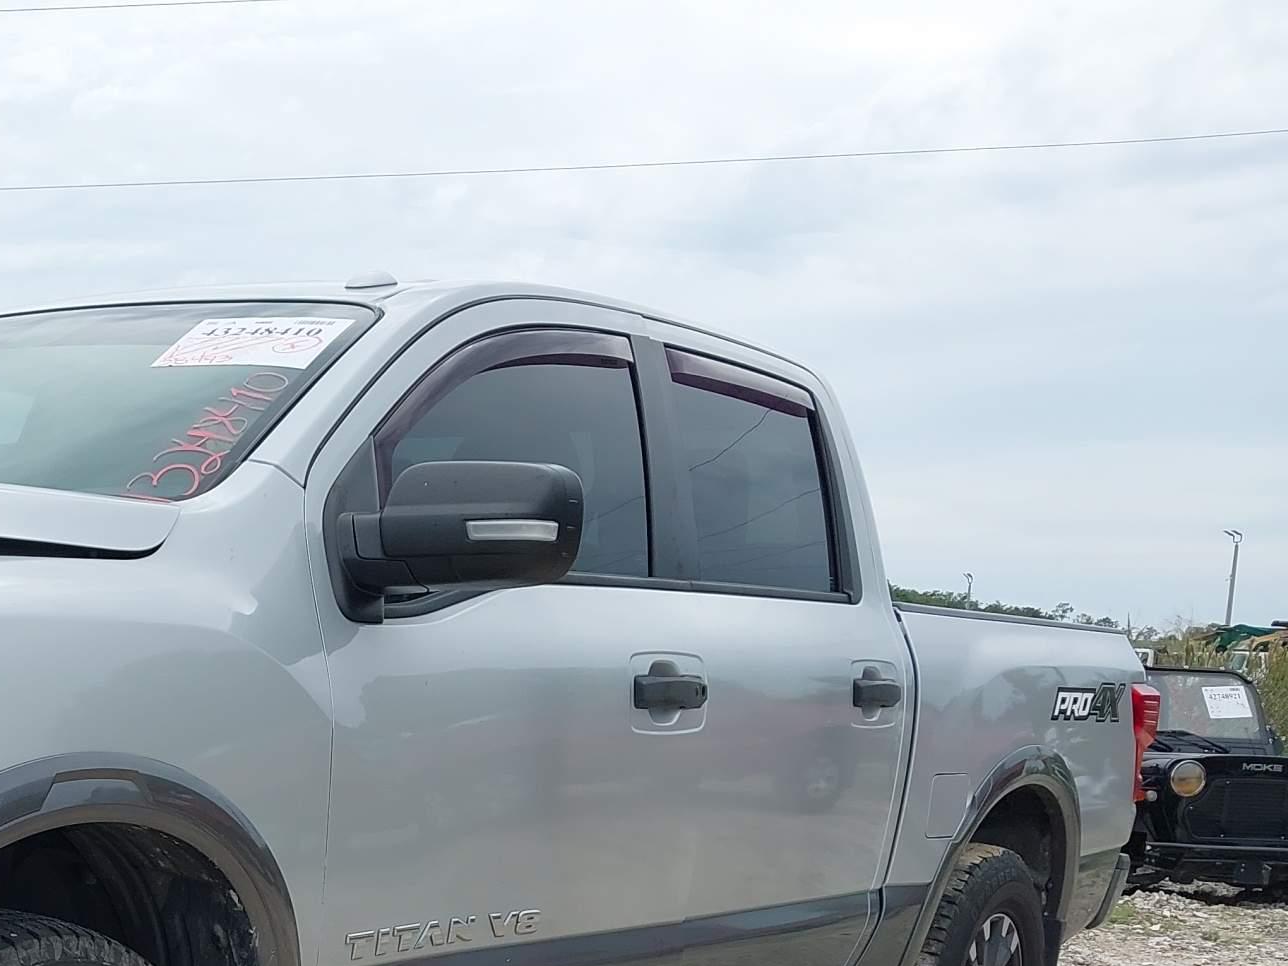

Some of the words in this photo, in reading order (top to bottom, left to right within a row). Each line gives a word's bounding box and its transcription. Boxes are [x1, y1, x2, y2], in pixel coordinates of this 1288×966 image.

[201, 326, 323, 337] 43248410
[121, 372, 288, 503] 3248410
[1242, 763, 1283, 772] MOKE
[345, 914, 476, 961] TITAN
[487, 908, 542, 938] V8
